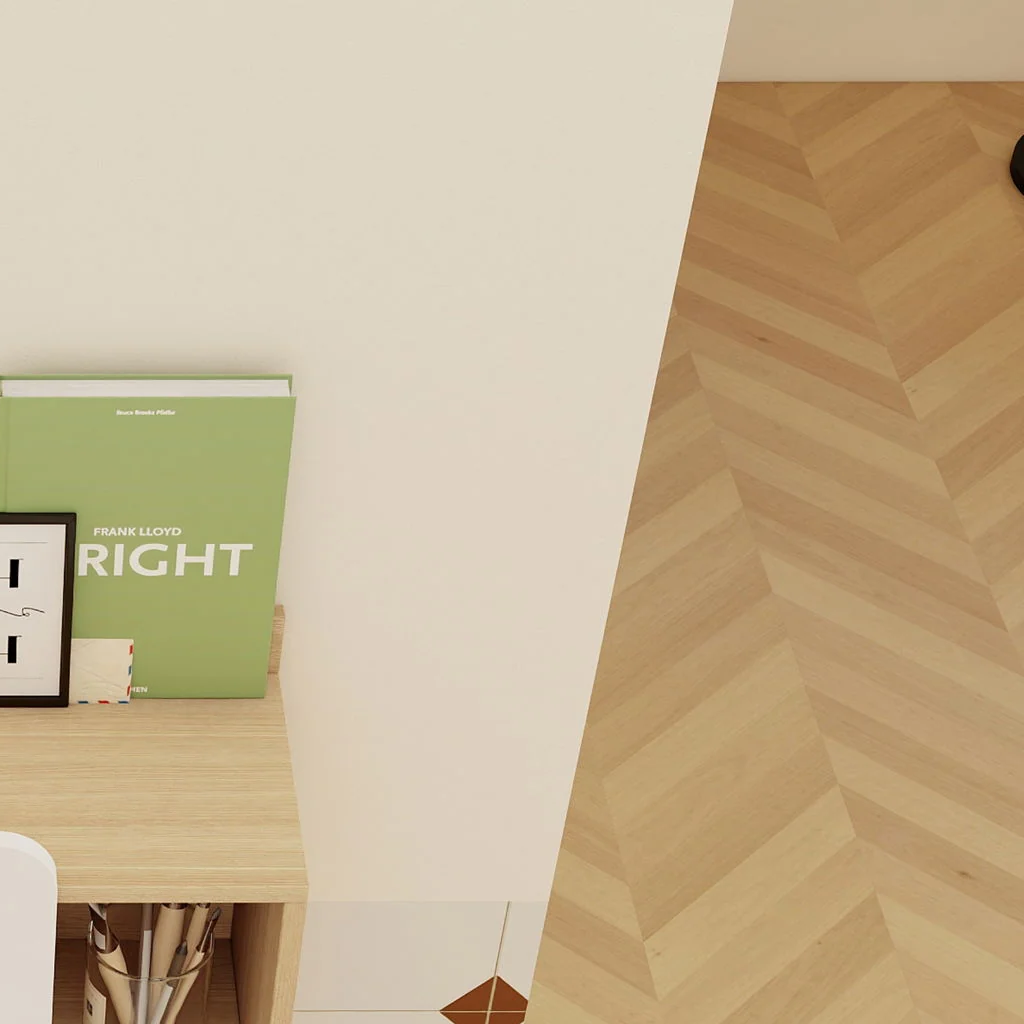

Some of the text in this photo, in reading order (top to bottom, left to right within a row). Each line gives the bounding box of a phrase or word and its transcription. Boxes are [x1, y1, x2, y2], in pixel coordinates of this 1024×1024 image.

[93, 527, 182, 537] FRANK LLOYD
[78, 543, 253, 577] RIGHT
